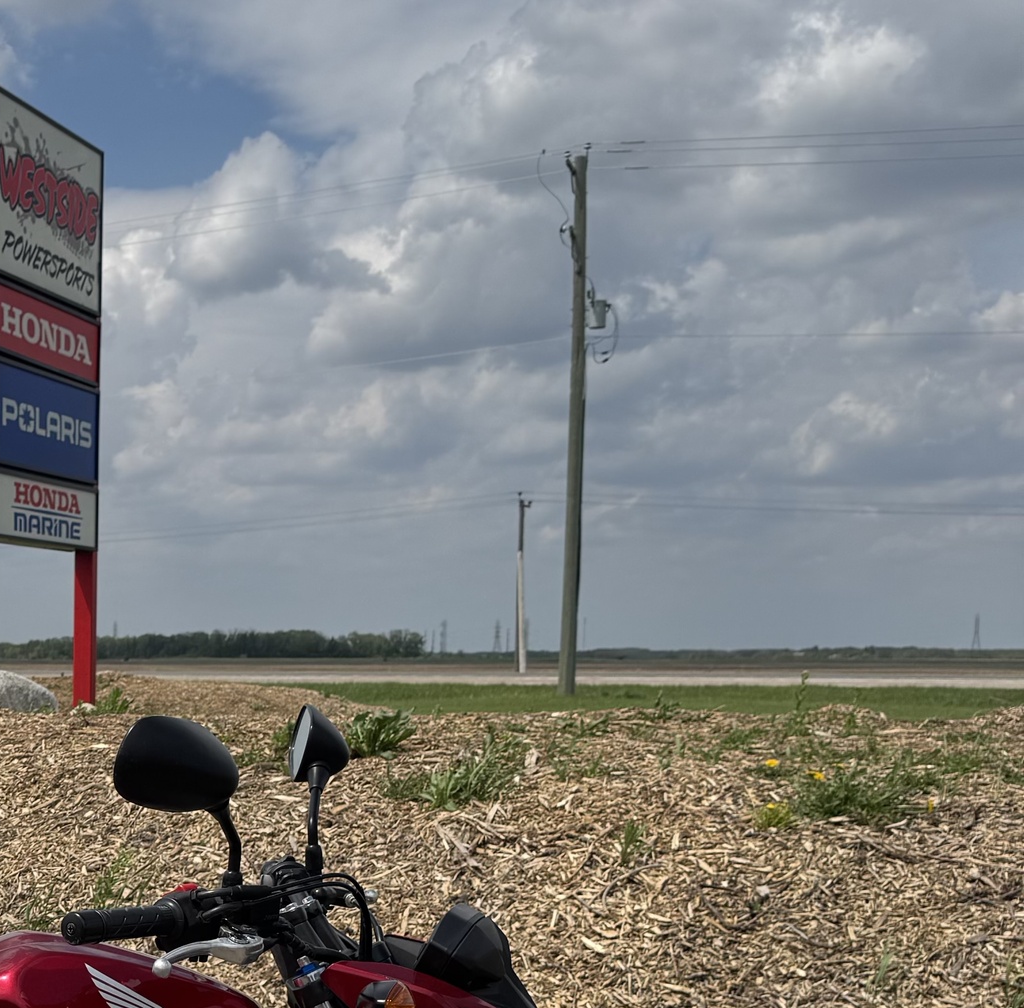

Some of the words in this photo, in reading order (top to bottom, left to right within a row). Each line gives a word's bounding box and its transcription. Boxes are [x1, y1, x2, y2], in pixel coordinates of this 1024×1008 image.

[1, 230, 95, 296] POWERSPORTS
[1, 302, 92, 366] HONDA
[1, 397, 92, 449] POLARIS
[14, 481, 81, 515] HONDA
